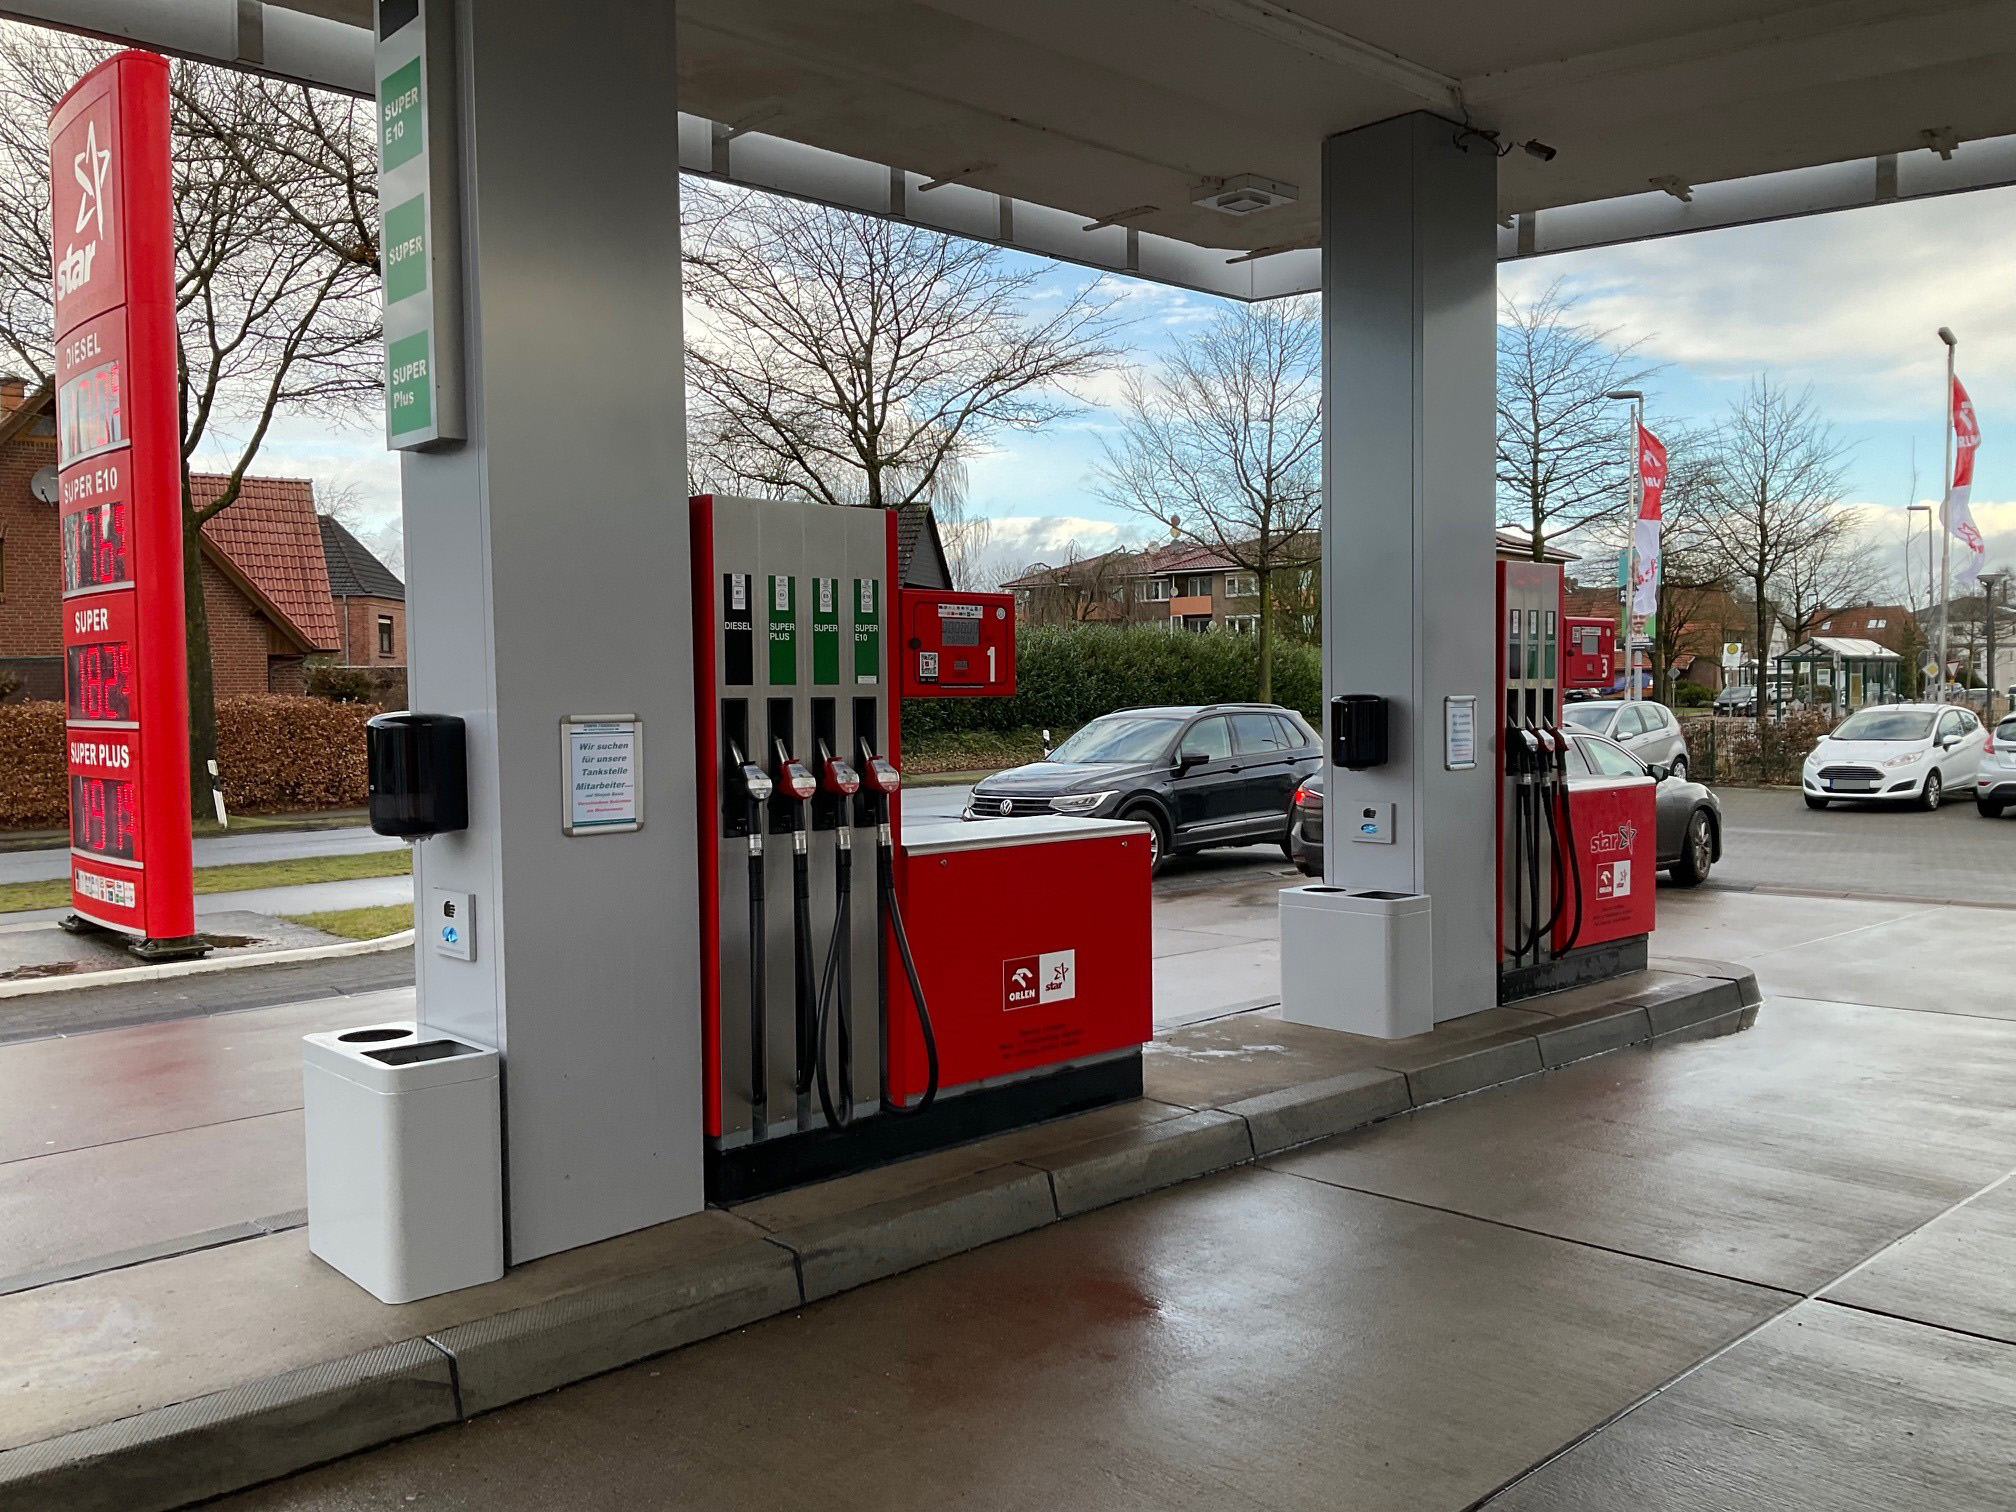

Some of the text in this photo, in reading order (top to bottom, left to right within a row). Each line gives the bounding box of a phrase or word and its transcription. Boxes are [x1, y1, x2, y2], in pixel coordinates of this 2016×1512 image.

[384, 86, 419, 122] SUPER
[385, 120, 404, 146] E10
[389, 235, 423, 266] SUPER
[57, 240, 96, 301] star
[66, 332, 101, 369] DIESEL
[392, 359, 427, 386] SUPER
[393, 390, 415, 409] Plus
[64, 466, 118, 504] SUPER E10
[75, 608, 108, 634] SUPER
[724, 622, 752, 631] DIESEL
[769, 623, 796, 631] SUPER
[814, 624, 839, 632] SUPER
[855, 624, 879, 632] SUPER
[769, 633, 790, 641] PLUS
[855, 634, 868, 642] E10
[986, 646, 996, 682] 1
[1601, 658, 1608, 678] 3
[71, 742, 130, 768] SUPER PLUS
[597, 742, 628, 750] suchen
[597, 755, 627, 763] unsere
[582, 767, 628, 776] Tankstelle
[1590, 830, 1618, 854] star
[1009, 989, 1035, 1001] ORLEN
[1045, 981, 1062, 991] star
